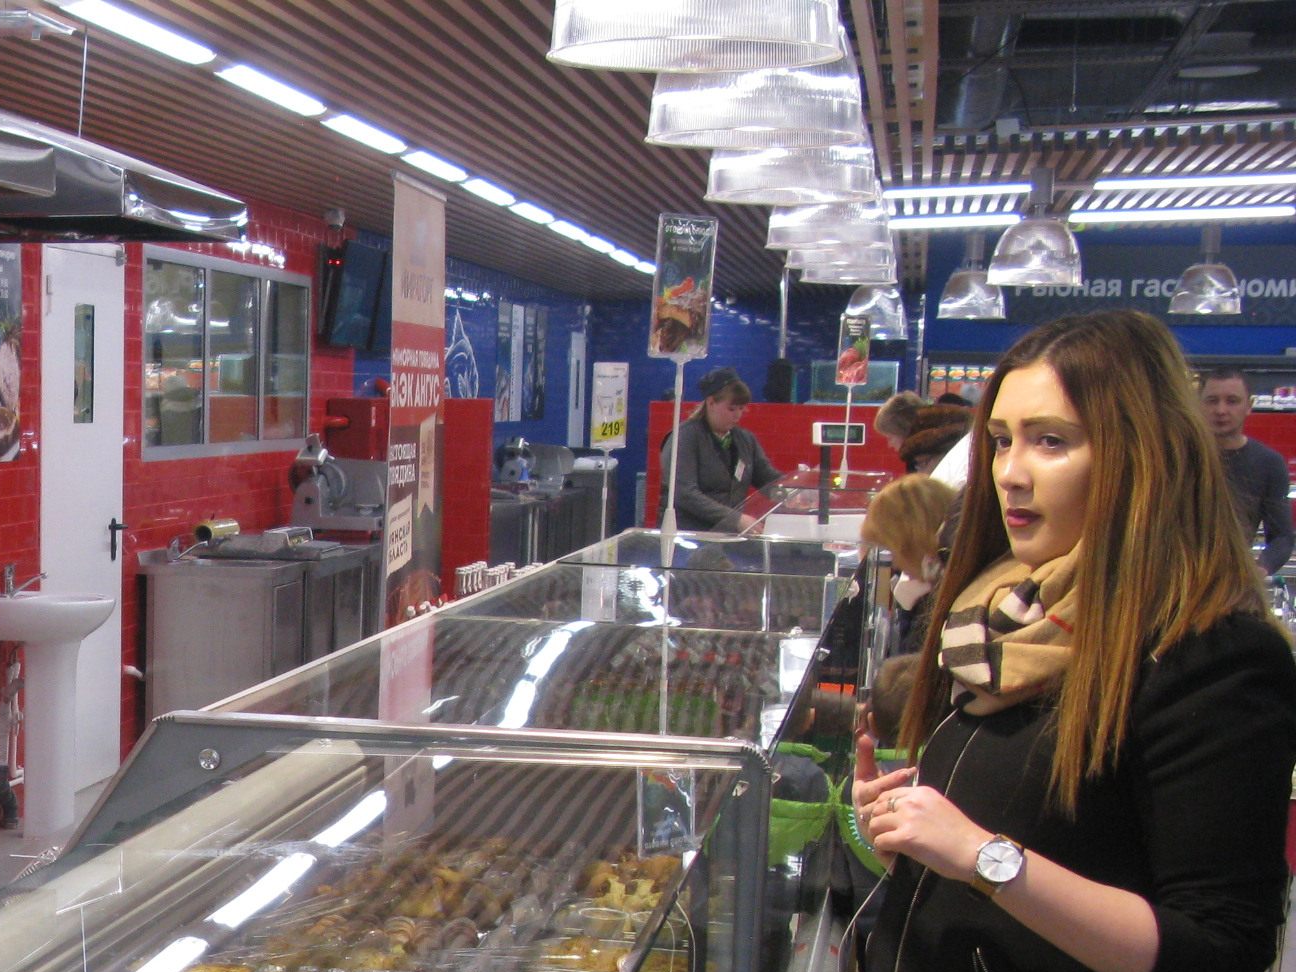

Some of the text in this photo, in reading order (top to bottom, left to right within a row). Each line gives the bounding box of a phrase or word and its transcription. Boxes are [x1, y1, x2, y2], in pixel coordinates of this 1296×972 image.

[1131, 278, 1296, 298] гасном
[415, 373, 441, 408] АНГУС
[601, 421, 620, 436] 219
[388, 521, 411, 547] РЯНСКАЯ
[388, 541, 408, 566] БЛАСТЬ
